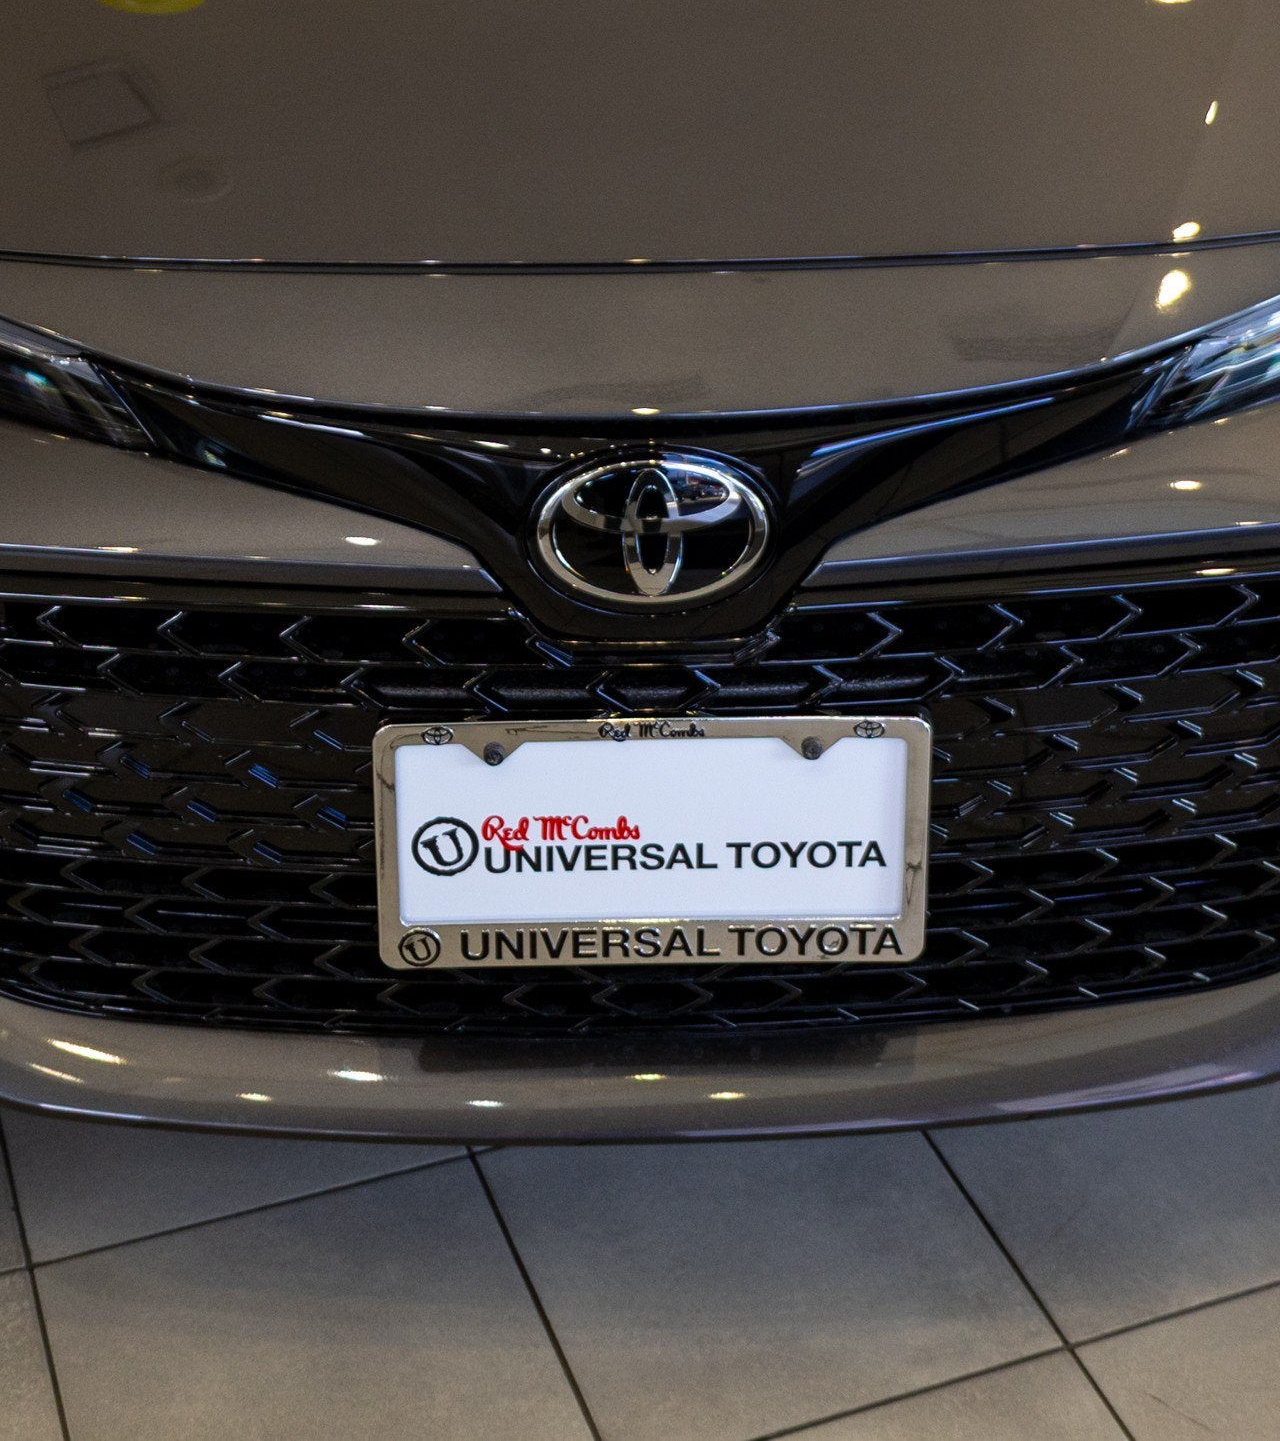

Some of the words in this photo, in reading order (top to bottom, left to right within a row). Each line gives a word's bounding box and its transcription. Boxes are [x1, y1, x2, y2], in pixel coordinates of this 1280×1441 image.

[598, 720, 634, 742] Red
[481, 814, 530, 850] Red
[532, 814, 641, 842] McCombs
[483, 842, 718, 875] UNIVERSAL
[725, 840, 888, 869] TOYOTA
[460, 925, 721, 960] UNIVERSAL
[728, 924, 904, 957] TOYOTA
